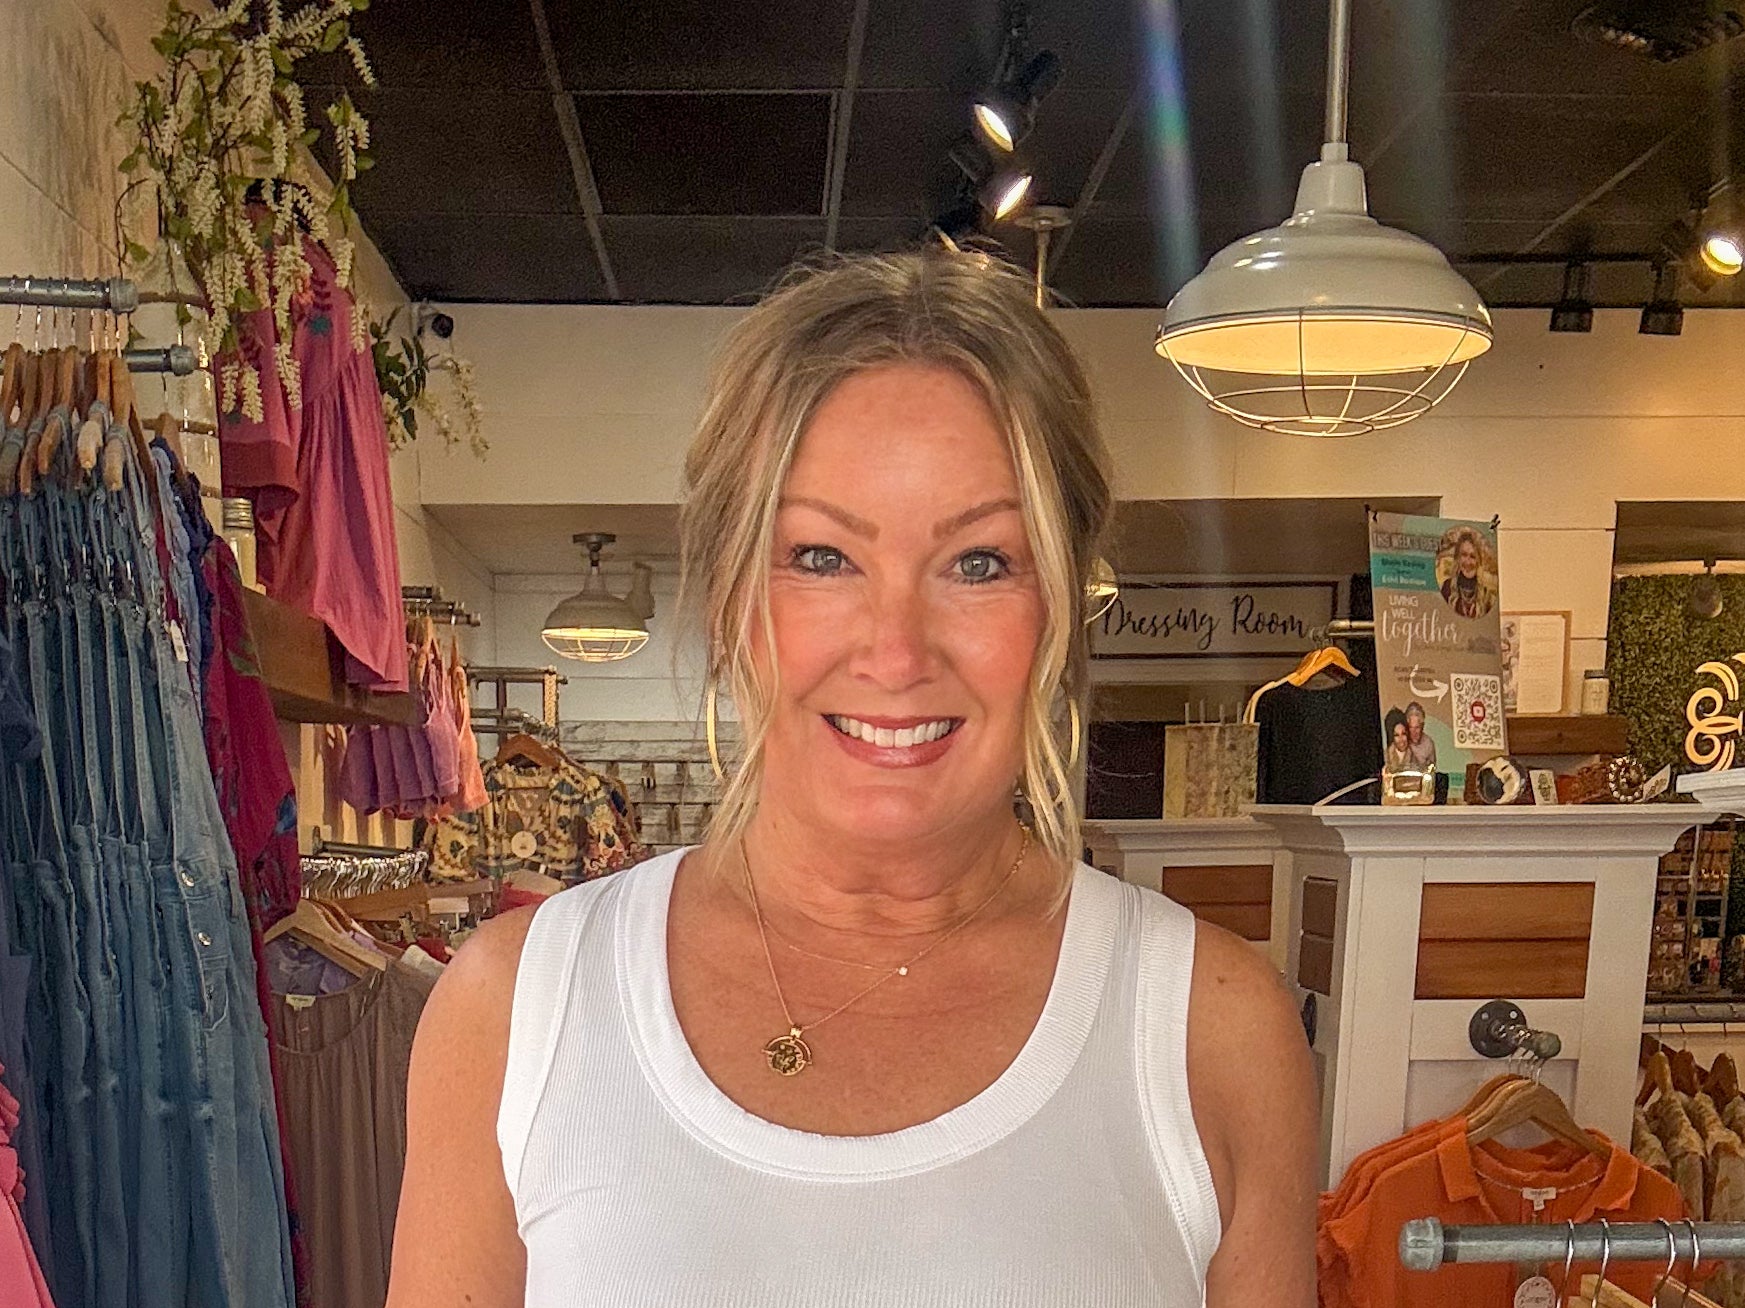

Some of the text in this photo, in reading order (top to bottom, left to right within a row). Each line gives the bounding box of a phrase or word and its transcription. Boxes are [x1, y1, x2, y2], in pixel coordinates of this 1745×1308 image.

[1388, 595, 1419, 607] LIVING
[1391, 607, 1416, 620] WELL
[1103, 593, 1310, 651] Dressing Room
[1382, 608, 1459, 657] together
